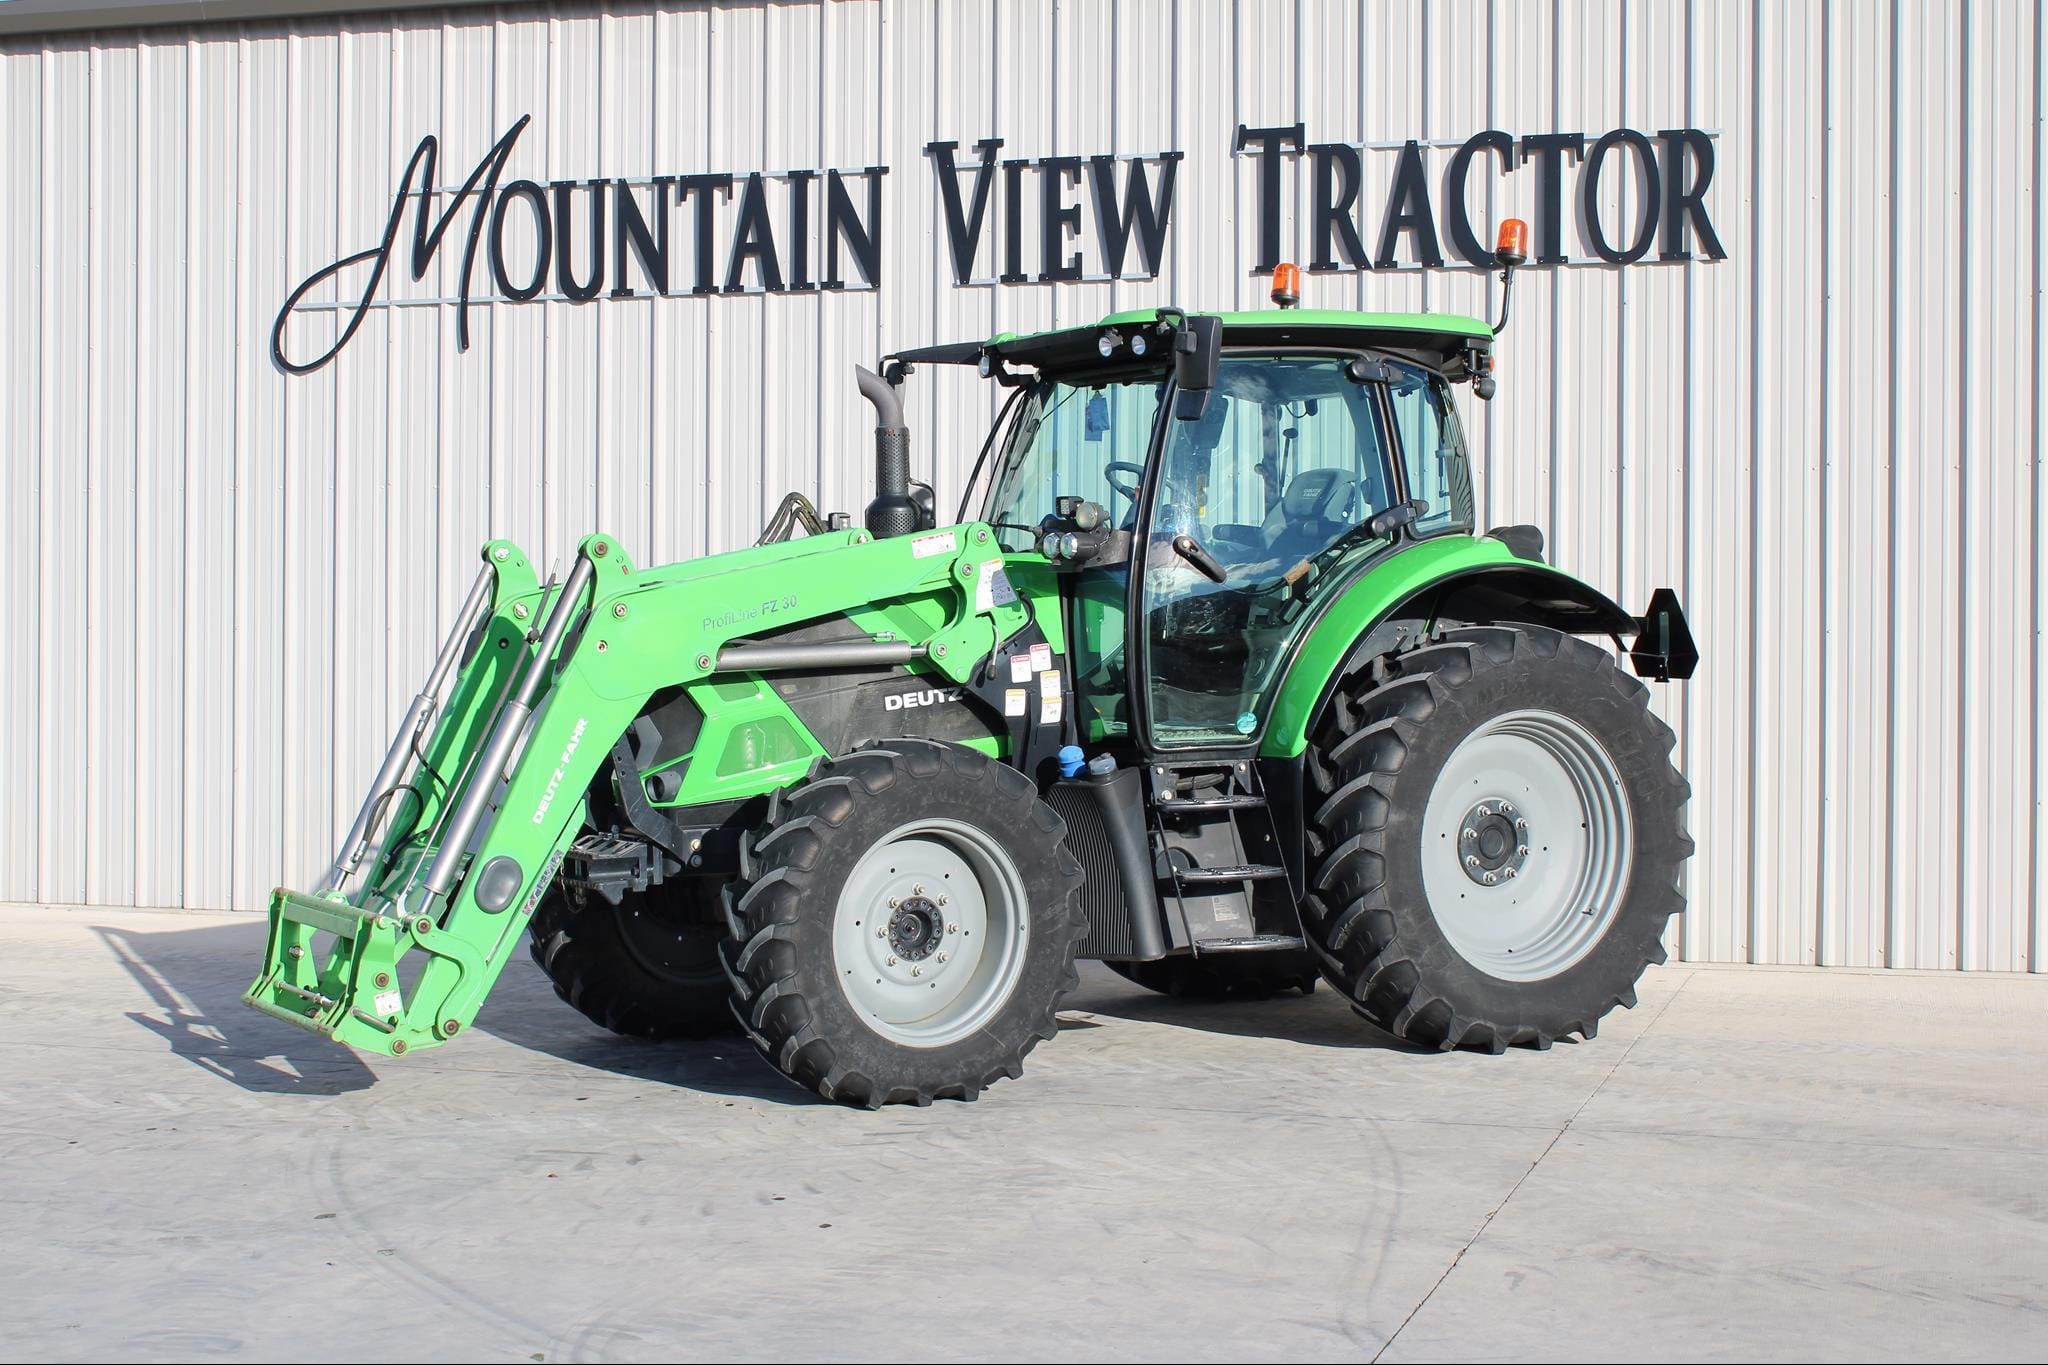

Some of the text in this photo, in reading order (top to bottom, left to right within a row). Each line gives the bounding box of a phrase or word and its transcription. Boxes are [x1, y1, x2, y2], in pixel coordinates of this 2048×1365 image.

[274, 114, 1727, 373] MOUNTAIN VIEW TRACTOR
[762, 599, 779, 616] FZ
[782, 594, 797, 610] 30
[885, 686, 963, 711] DEUTZ
[532, 718, 589, 825] DEUTZ-FAHR
